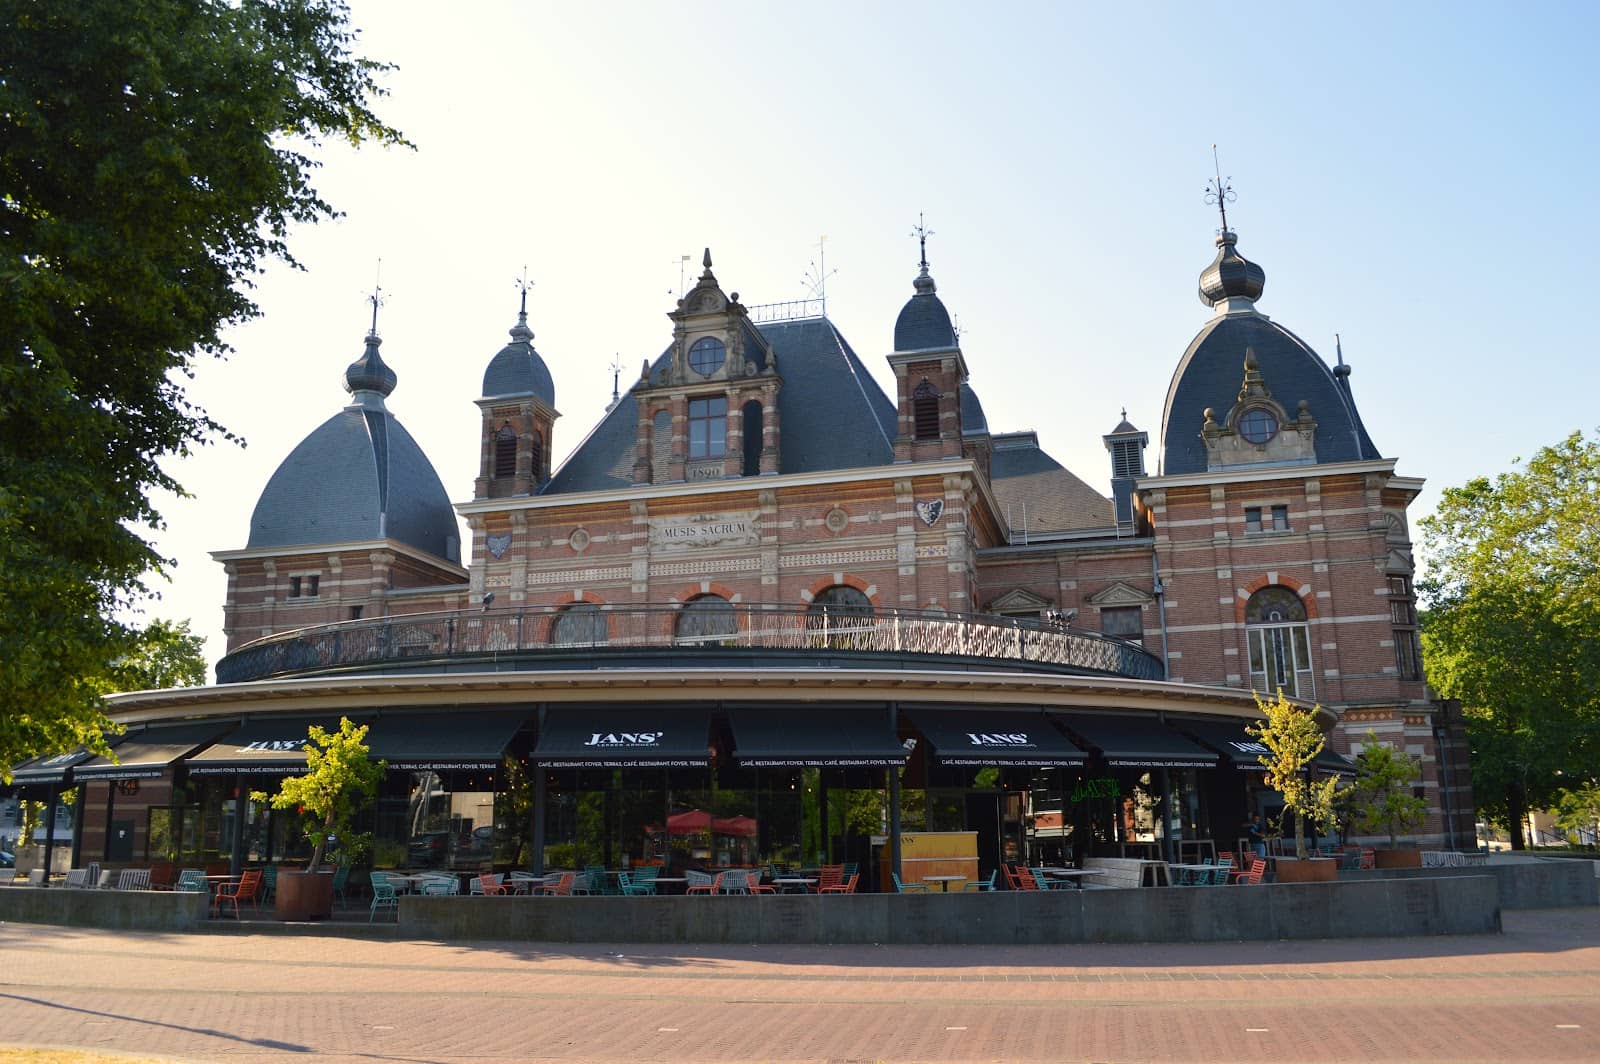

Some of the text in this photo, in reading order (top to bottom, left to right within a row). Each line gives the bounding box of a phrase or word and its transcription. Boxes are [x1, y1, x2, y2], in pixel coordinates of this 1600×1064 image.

[691, 468, 720, 478] 1890
[664, 523, 745, 538] MUSIS SACRUM
